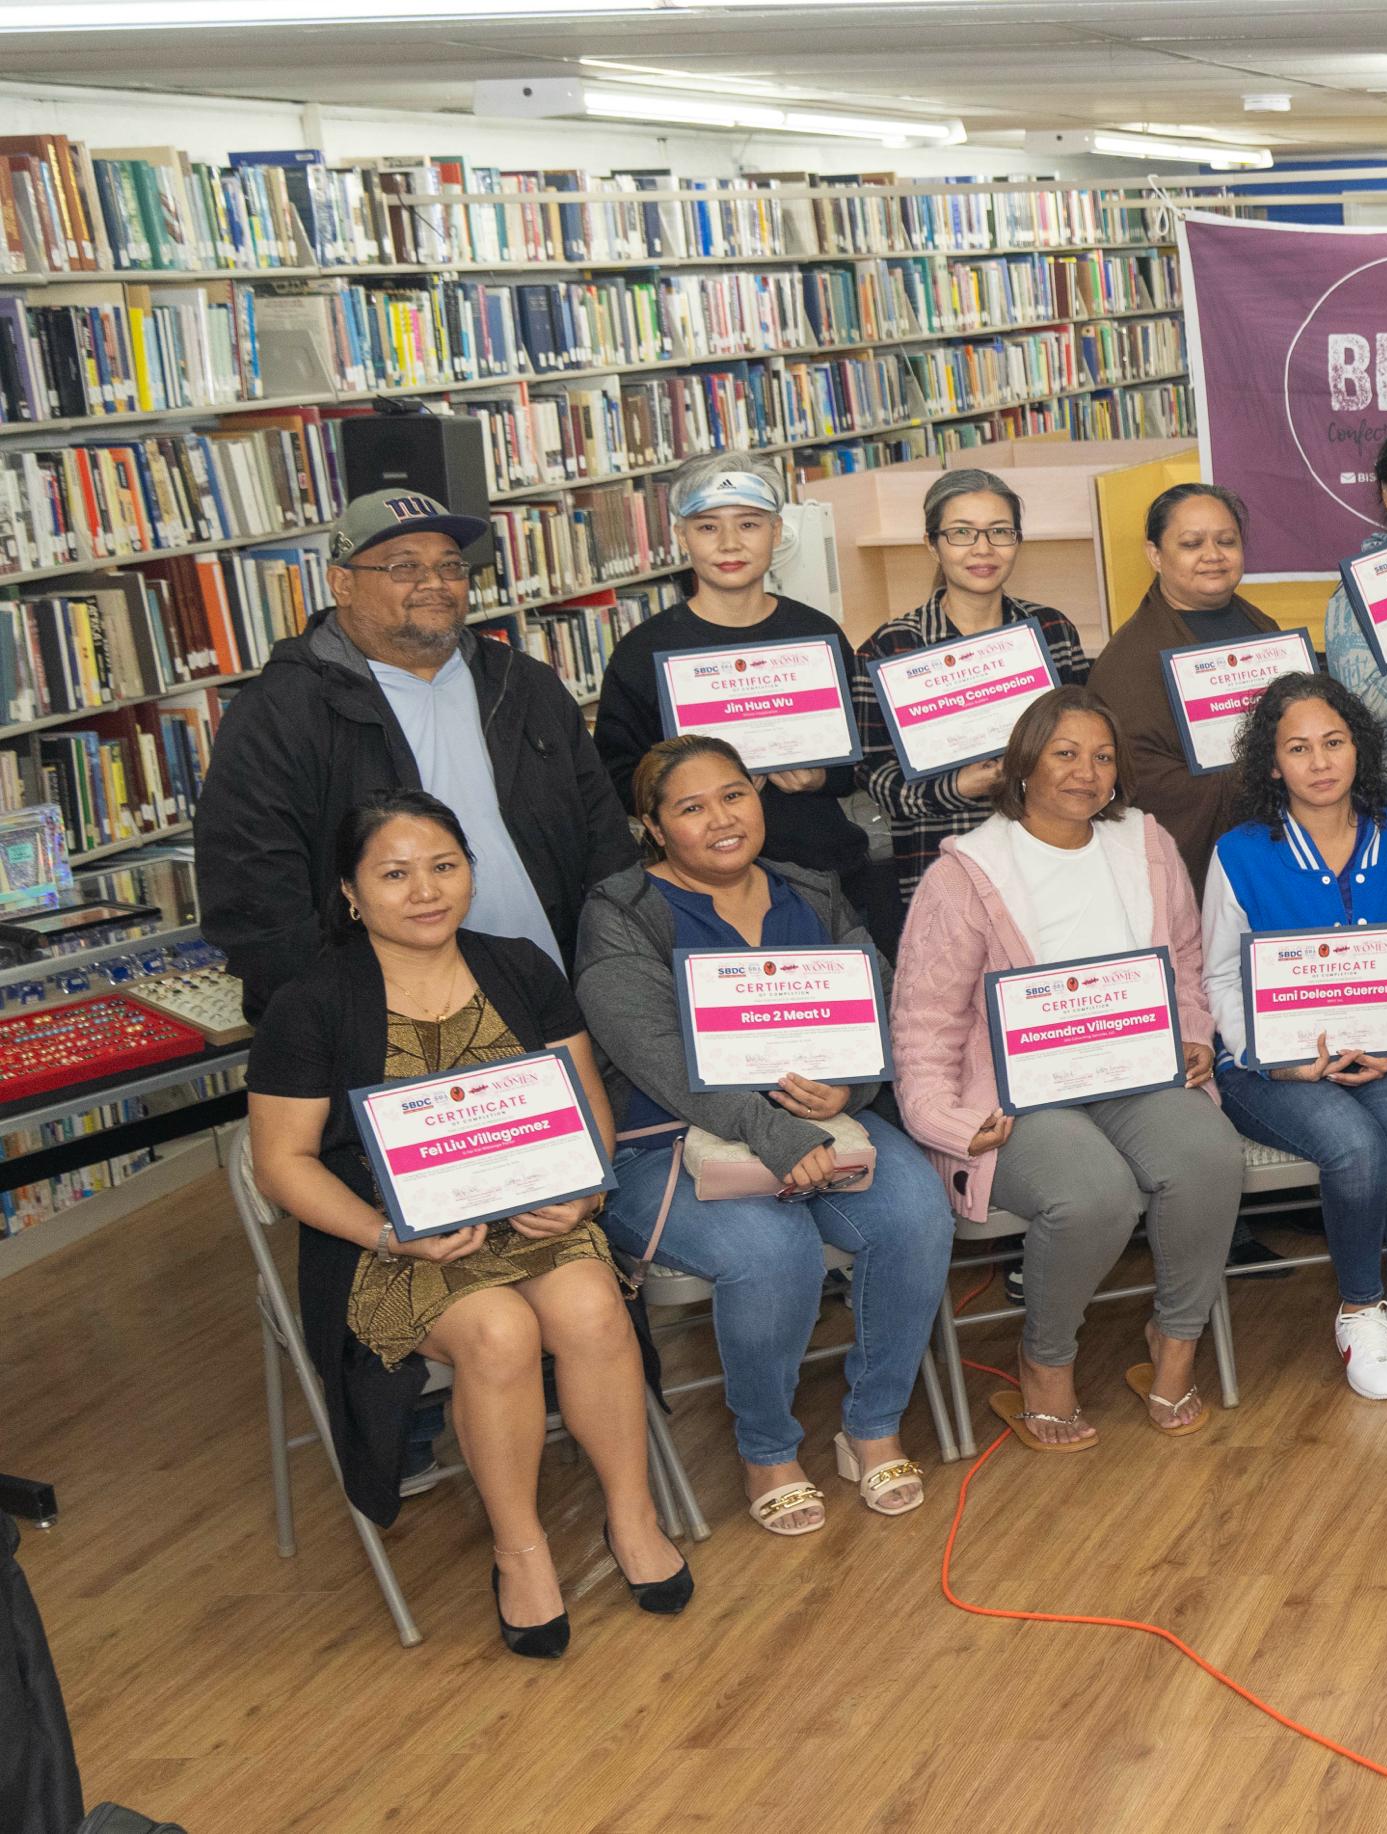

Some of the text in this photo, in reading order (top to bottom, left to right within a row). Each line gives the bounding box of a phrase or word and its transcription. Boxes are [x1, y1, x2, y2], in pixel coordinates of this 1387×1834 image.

[1357, 472, 1377, 483] BIS
[712, 673, 797, 690] CERTIFICATE
[925, 659, 1005, 688] CERTIFICATE
[1210, 666, 1279, 685] CERTIFICATE
[909, 703, 937, 717] Wen
[938, 696, 965, 712] Ping
[966, 674, 1035, 701] Concepcion
[724, 703, 744, 714] Jin
[745, 699, 771, 711] Hua
[772, 697, 794, 708] Wu
[1210, 698, 1241, 712] Nadia
[718, 967, 745, 975] SBDC
[1292, 960, 1376, 975] CERTIFICATE
[736, 980, 830, 993] CERTIFICATE
[1026, 985, 1051, 996] SBDC
[1042, 991, 1128, 1012] CERTIFICATE
[1272, 991, 1298, 1003] Lani
[1300, 988, 1342, 1000] Deleon
[741, 1008, 830, 1023] Rice 2 Meat U
[1020, 1026, 1085, 1044] Alexandra
[1087, 1012, 1156, 1033] Villagomez
[401, 1098, 432, 1112] SBDC
[425, 1095, 527, 1127] CERTIFICATE
[419, 1145, 444, 1159] Fei
[445, 1138, 466, 1153] Liu
[468, 1119, 551, 1146] Villagomez
